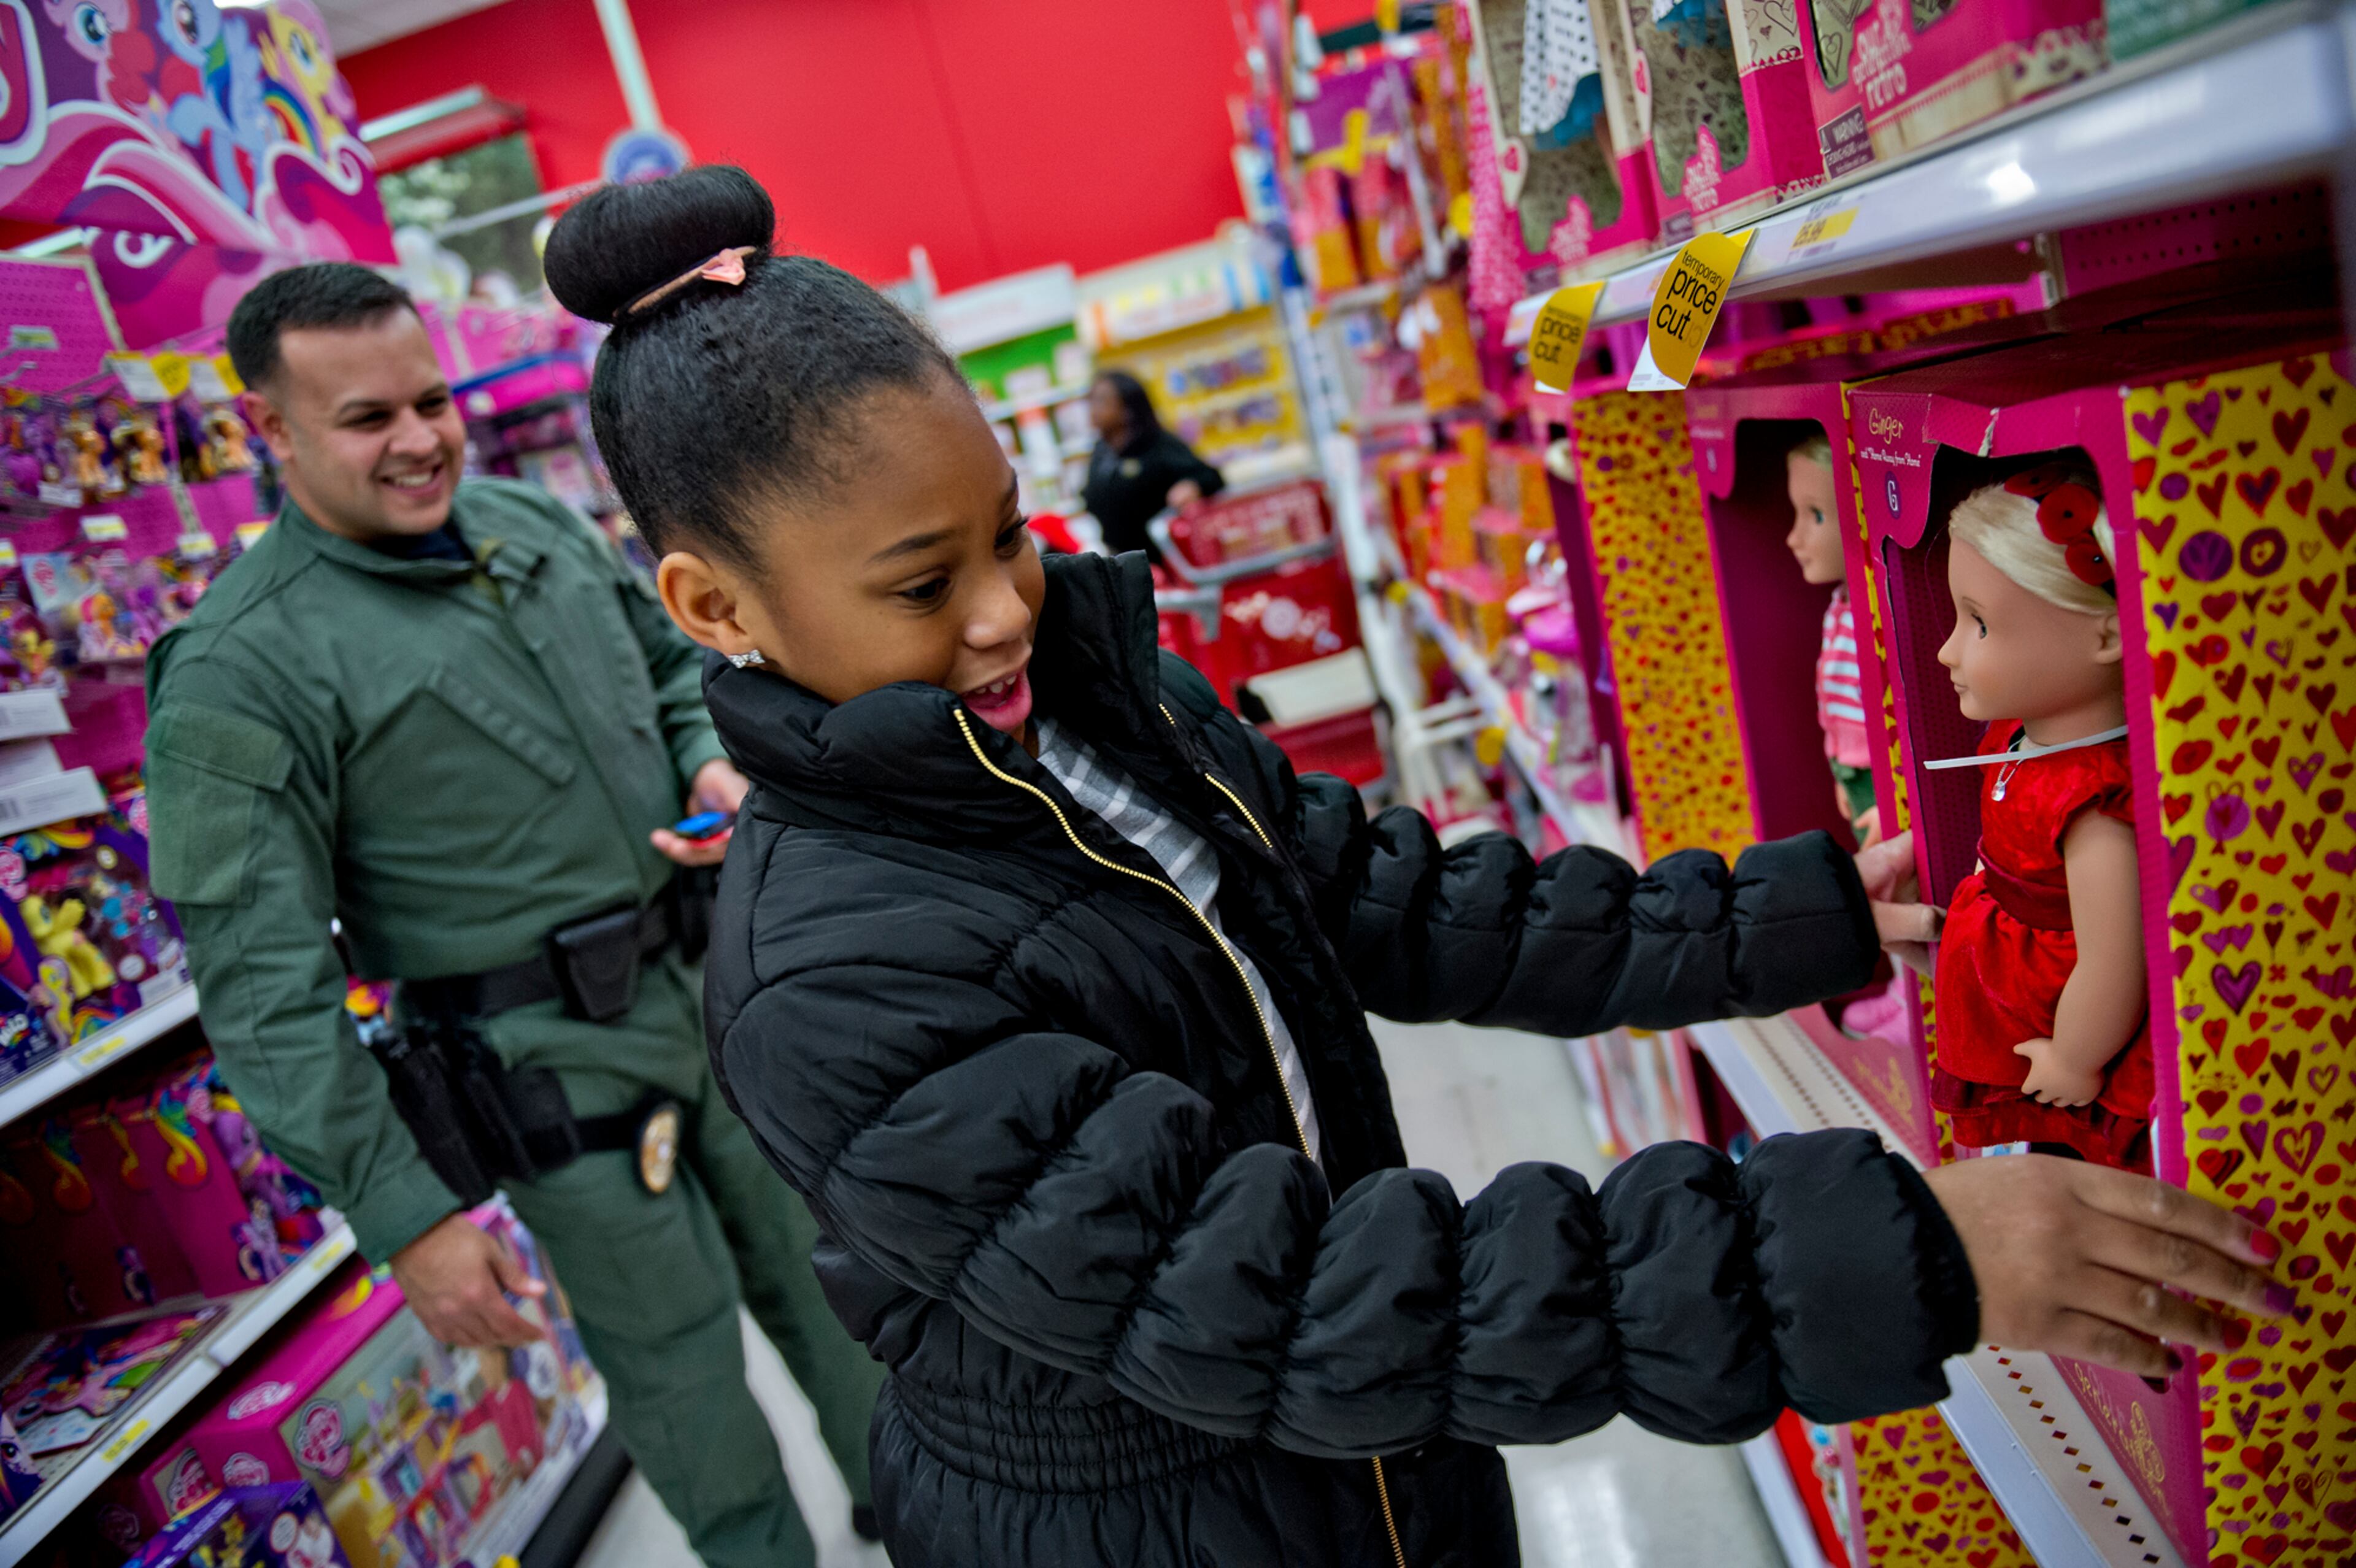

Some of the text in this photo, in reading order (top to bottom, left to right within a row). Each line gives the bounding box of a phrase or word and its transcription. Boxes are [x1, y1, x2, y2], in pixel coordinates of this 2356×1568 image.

[1682, 250, 1725, 291] temporary
[1666, 268, 1717, 314] price
[1539, 317, 1581, 344] price
[1657, 304, 1691, 340] cut
[1534, 340, 1561, 363] cut
[1869, 408, 1904, 444] Ginger
[1887, 480, 1898, 512] G
